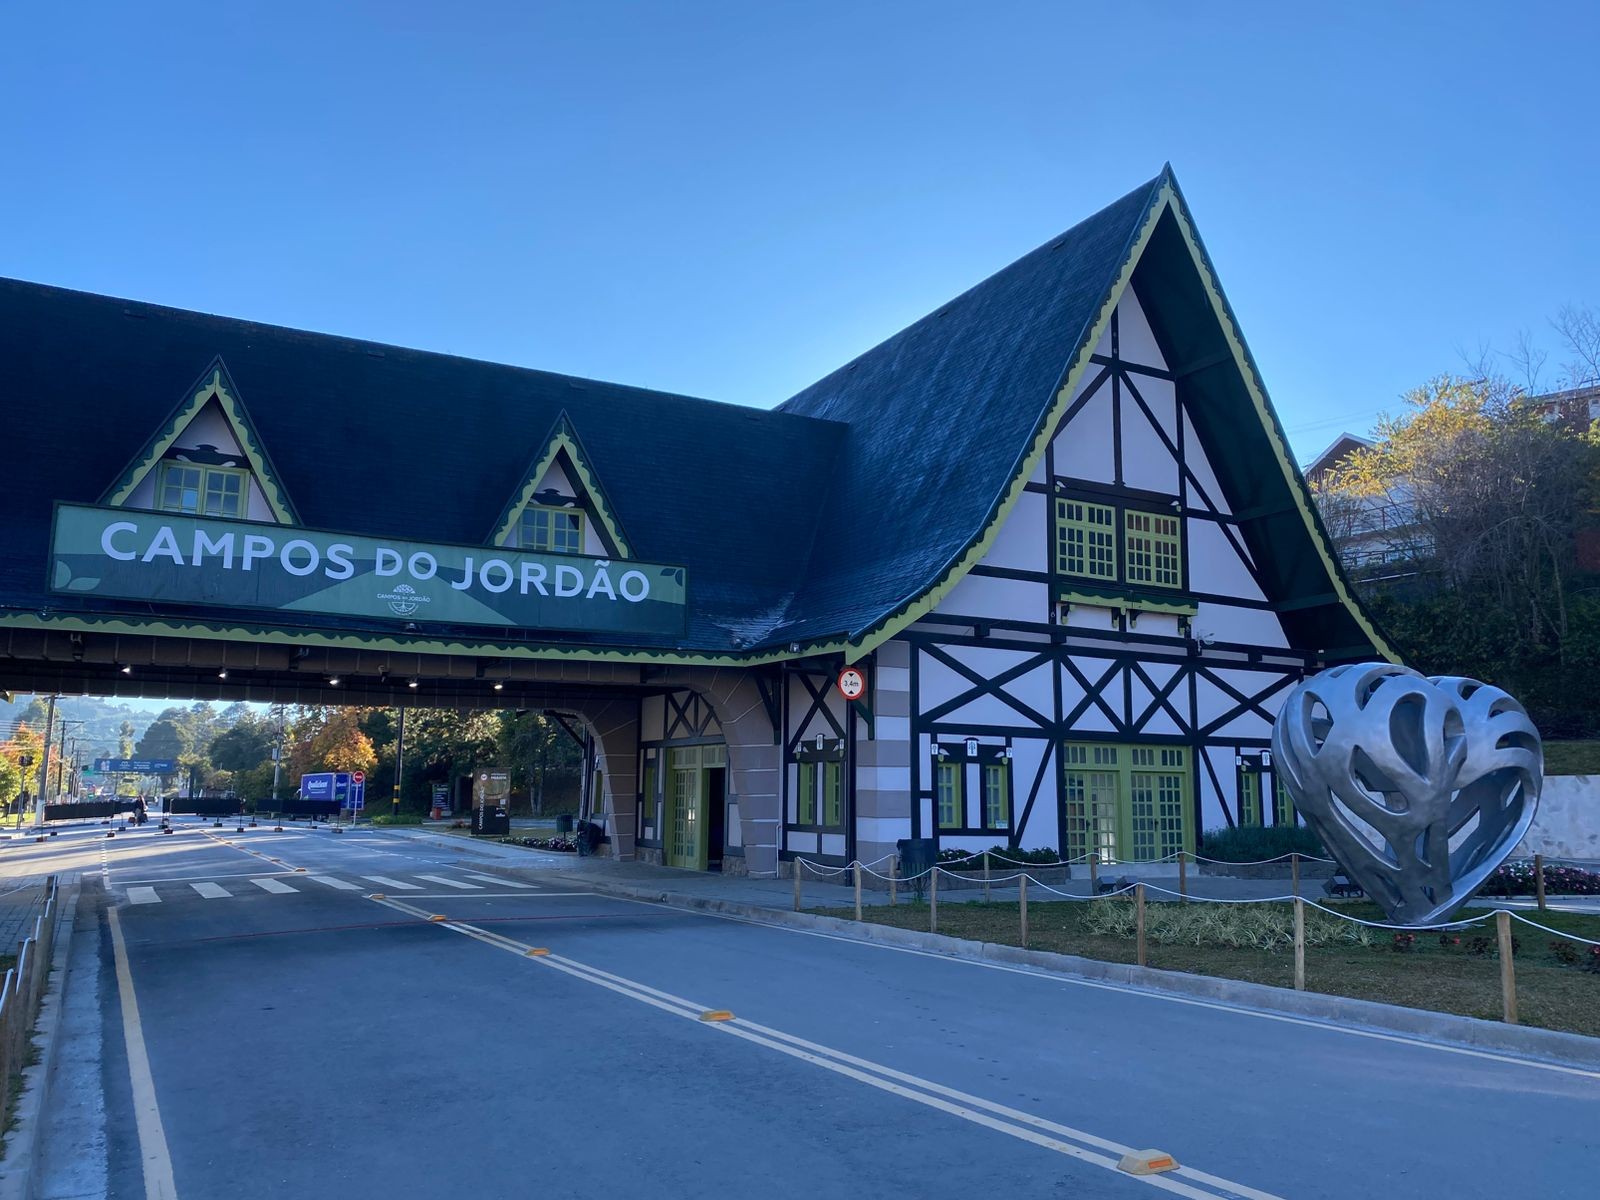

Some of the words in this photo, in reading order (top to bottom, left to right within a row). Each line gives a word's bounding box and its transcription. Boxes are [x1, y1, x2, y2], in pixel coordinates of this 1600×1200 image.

[101, 521, 355, 580] CAMPOS
[375, 548, 438, 580] DO
[451, 557, 650, 602] JORDÃO
